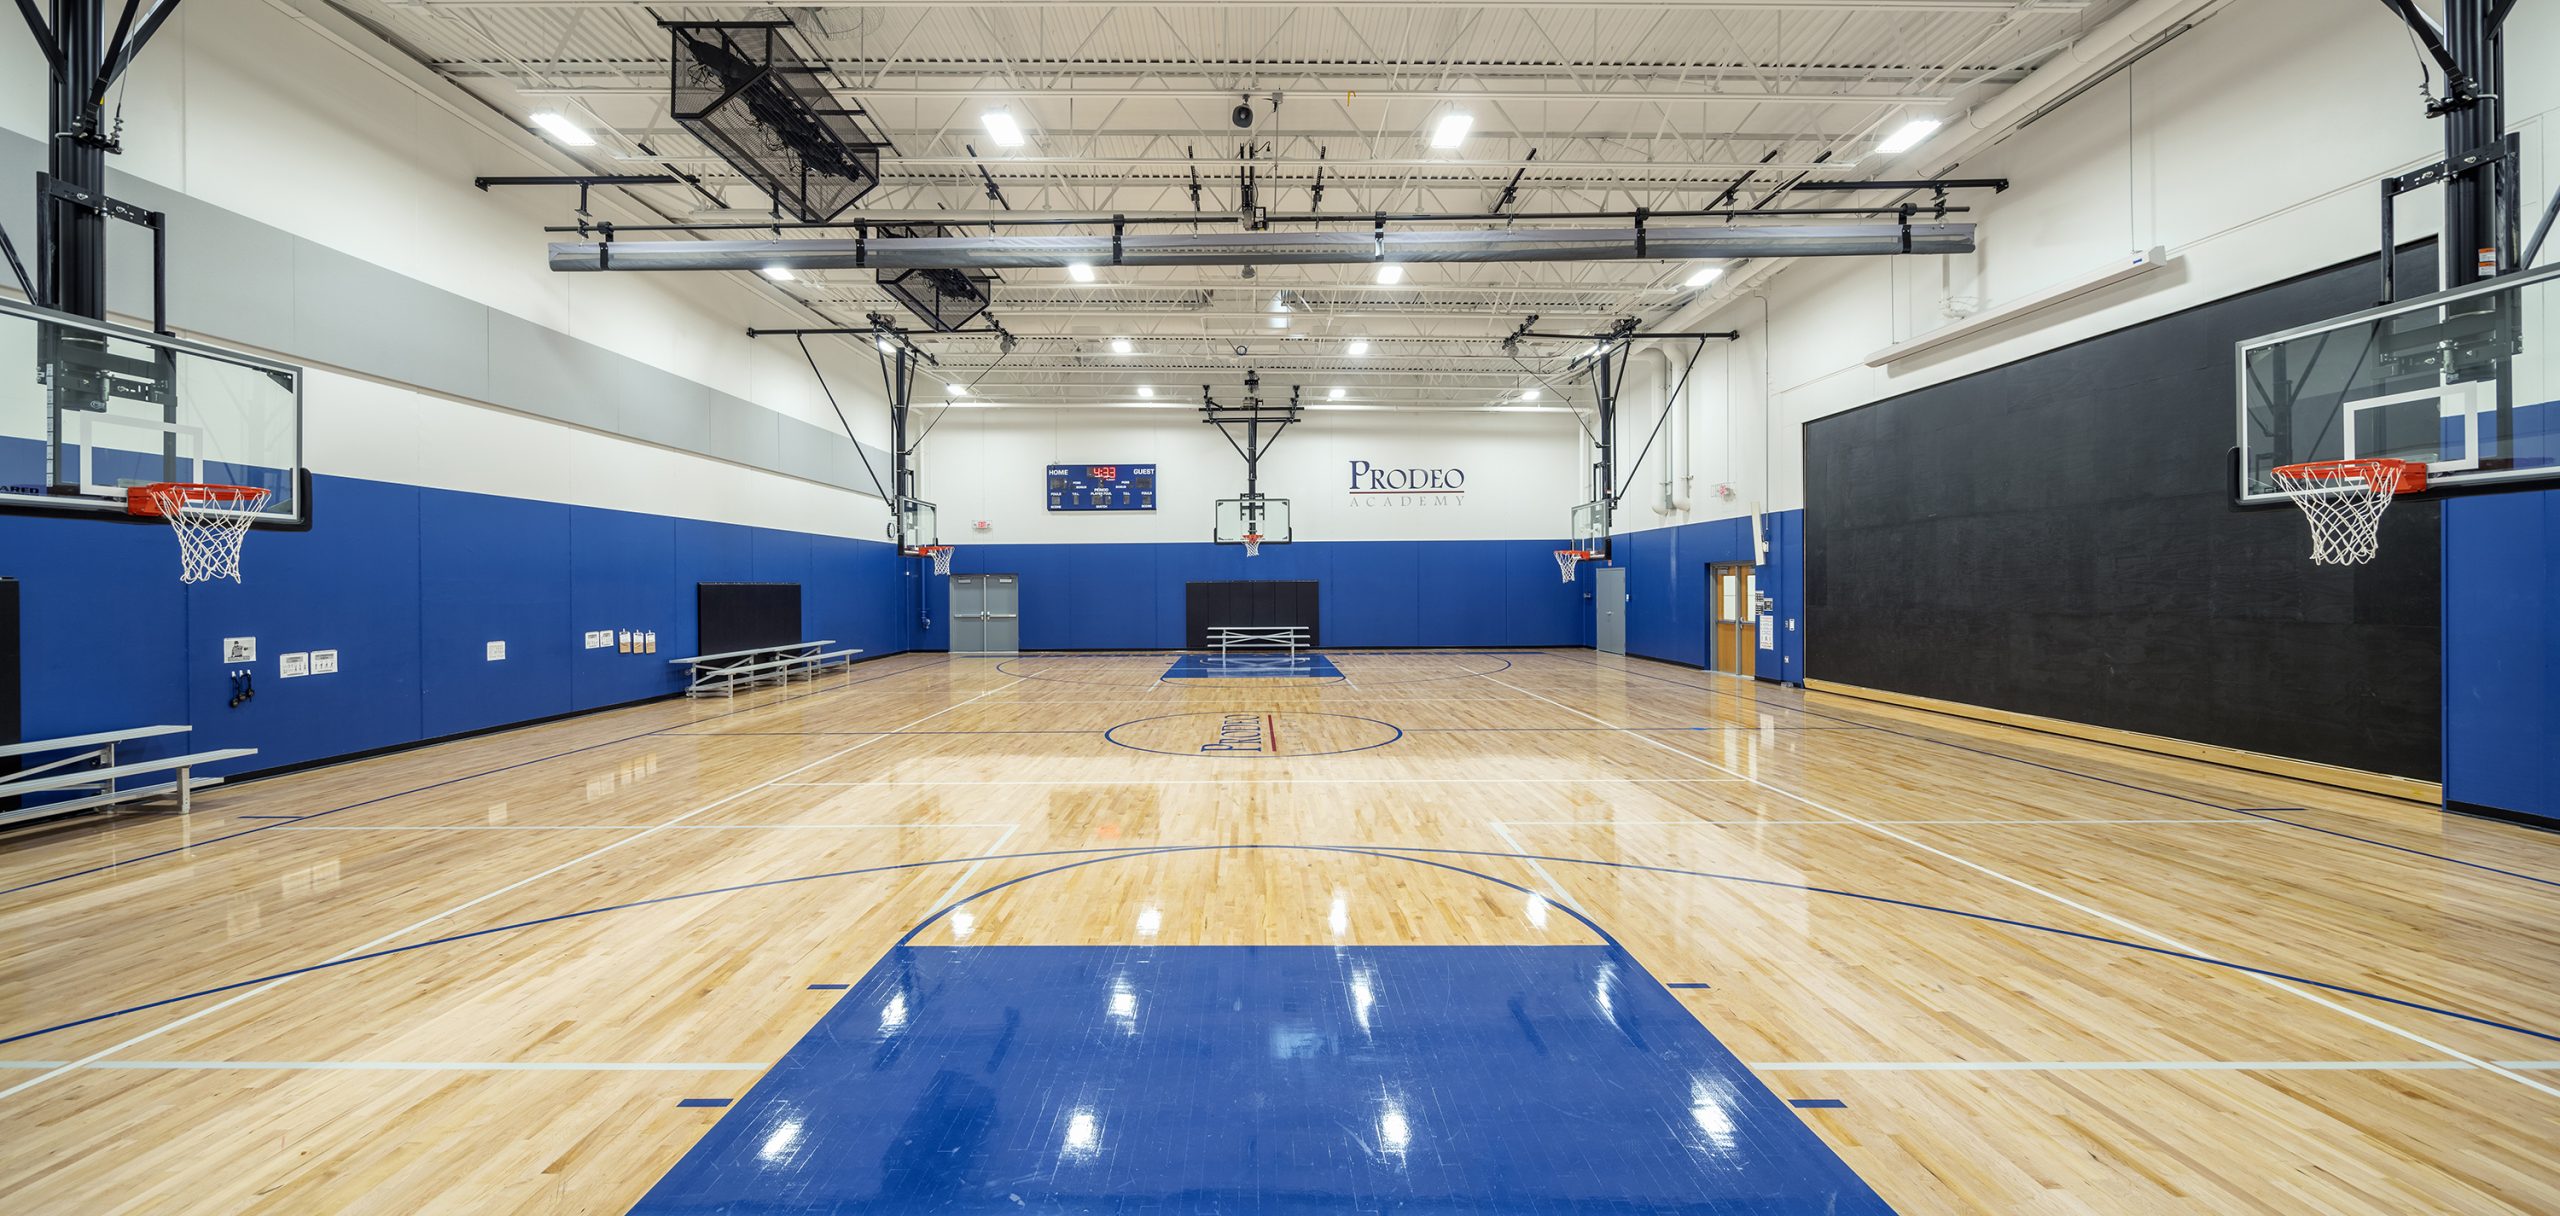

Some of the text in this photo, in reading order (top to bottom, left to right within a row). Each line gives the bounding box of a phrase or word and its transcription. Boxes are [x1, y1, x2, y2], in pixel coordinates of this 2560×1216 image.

[1093, 466, 1116, 479] 4:33
[1349, 460, 1465, 489] PRODEO
[1350, 496, 1465, 507] ACADEMY
